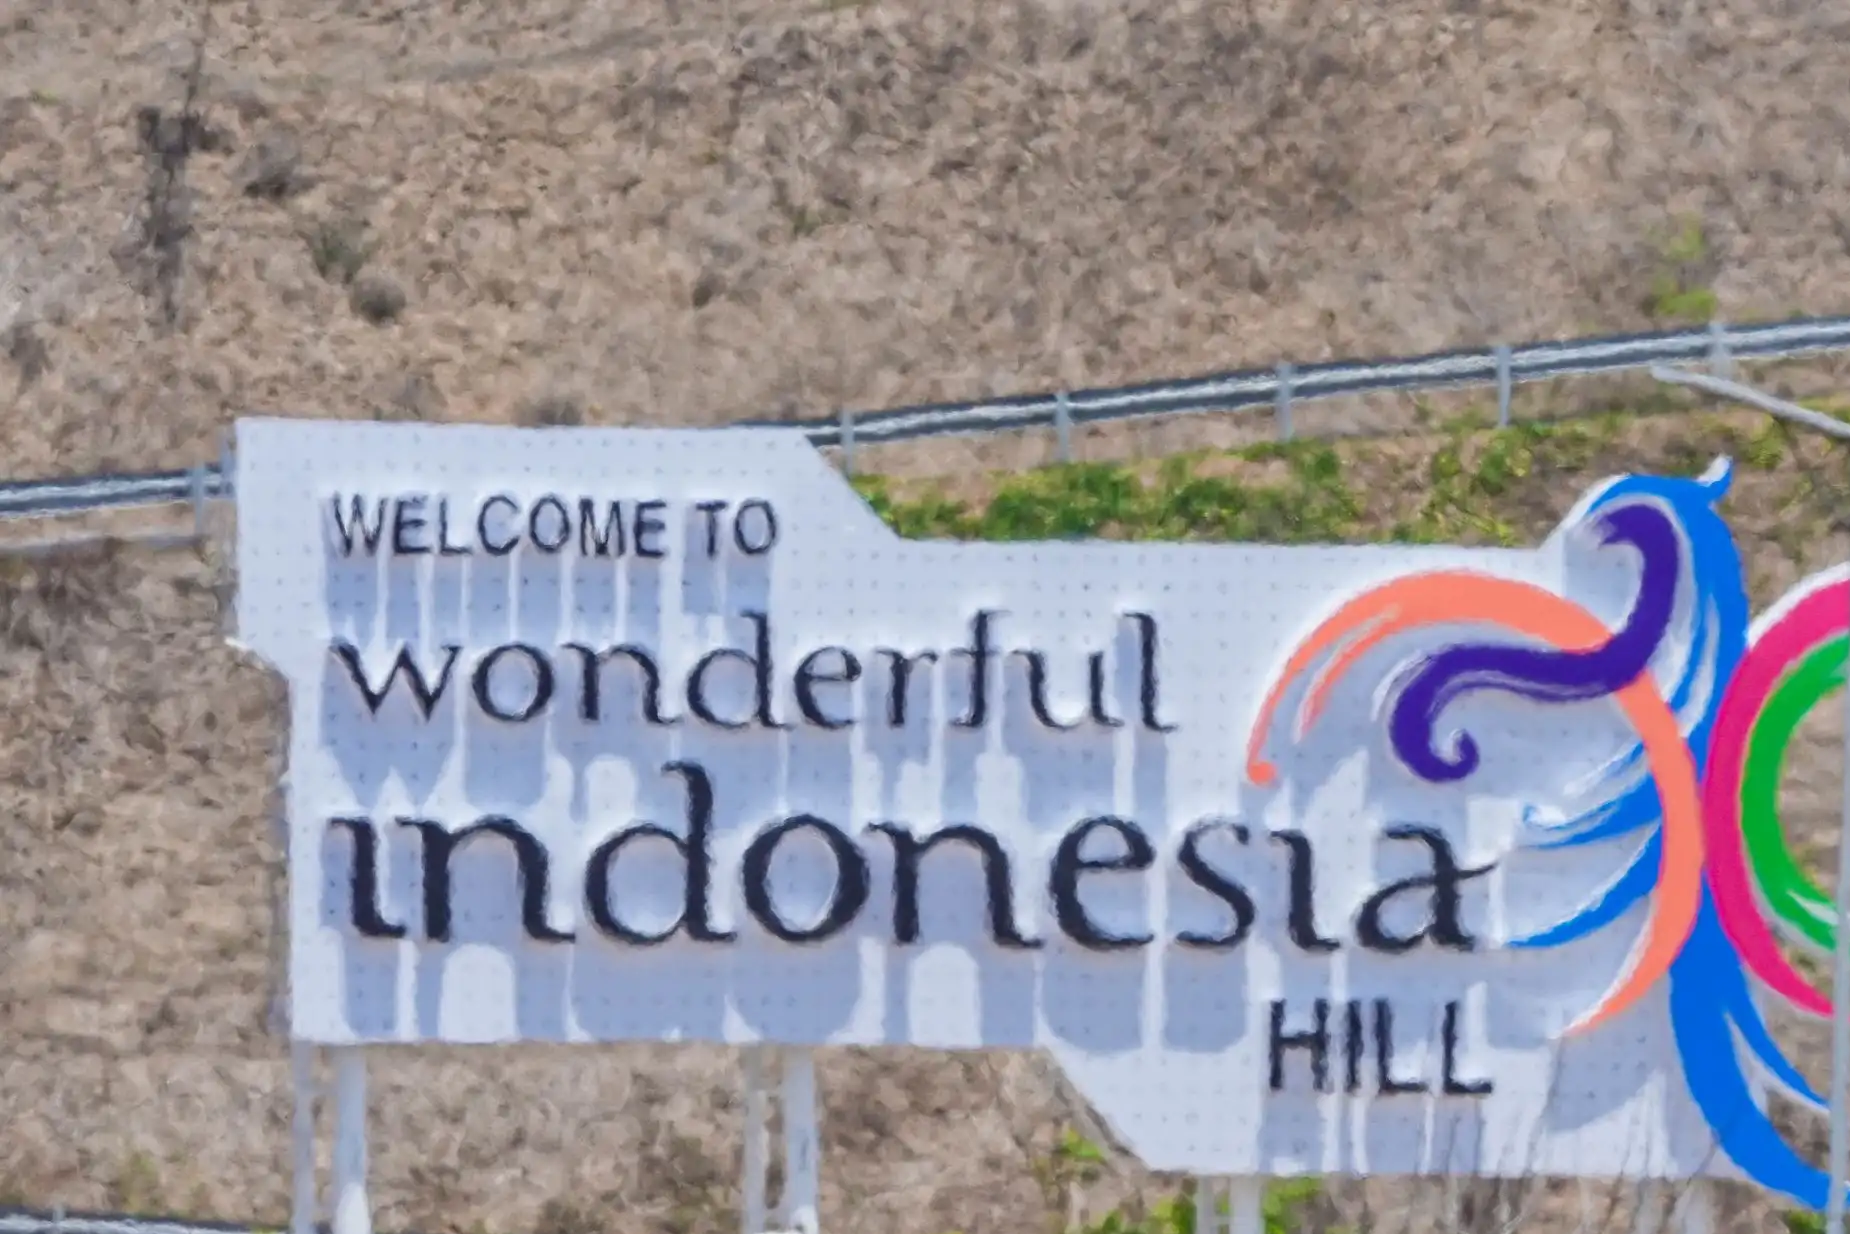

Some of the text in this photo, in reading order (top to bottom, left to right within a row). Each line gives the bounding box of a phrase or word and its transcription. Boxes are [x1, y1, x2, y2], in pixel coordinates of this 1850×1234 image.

[333, 495, 777, 560] WELCOME TO
[331, 610, 1175, 733] wonderful
[330, 761, 1494, 955] indonesia
[1268, 999, 1493, 1096] HILL
